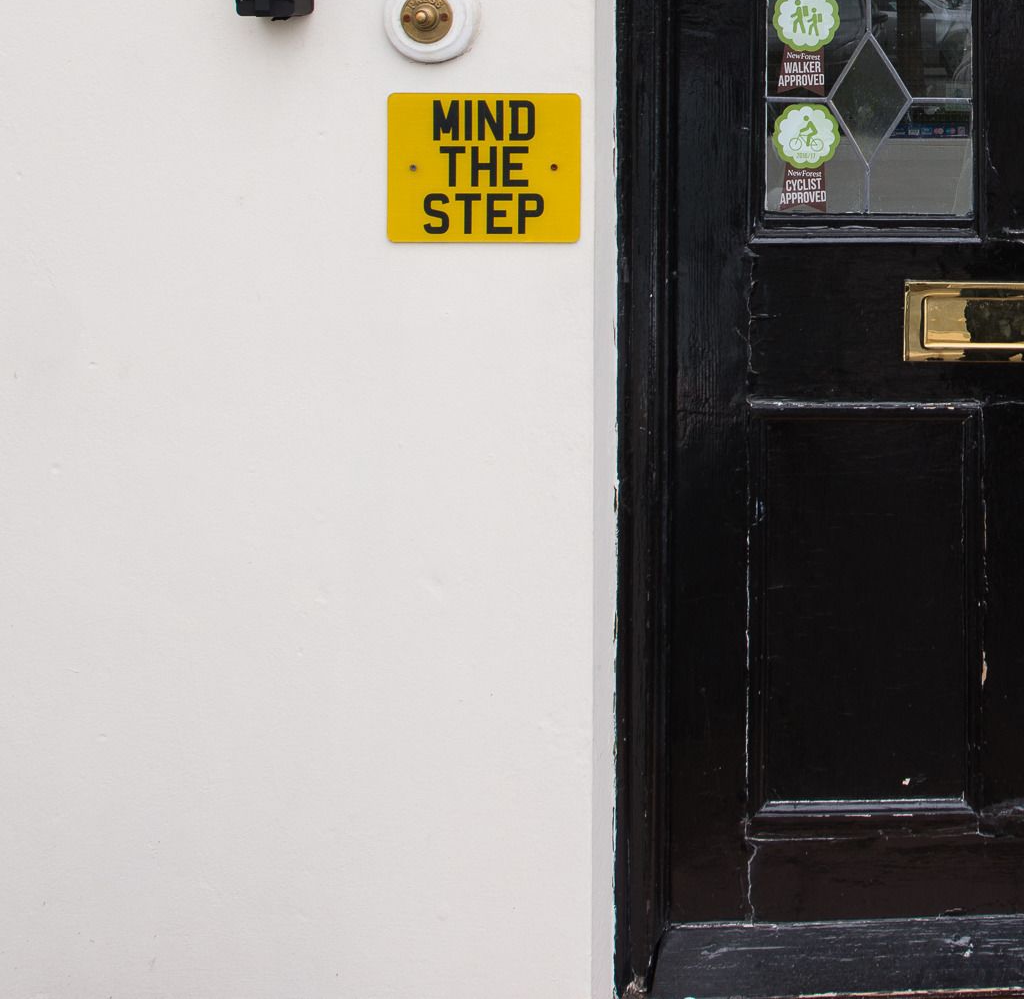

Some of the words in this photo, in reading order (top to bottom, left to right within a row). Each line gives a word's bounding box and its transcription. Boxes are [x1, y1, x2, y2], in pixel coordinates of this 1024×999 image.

[784, 61, 821, 74] WALKER
[778, 73, 825, 87] APPROVED
[432, 99, 536, 141] MIND
[439, 146, 529, 187] THE
[785, 178, 822, 191] CYCLIST
[779, 190, 827, 205] APPROVED
[423, 192, 544, 235] STEP
